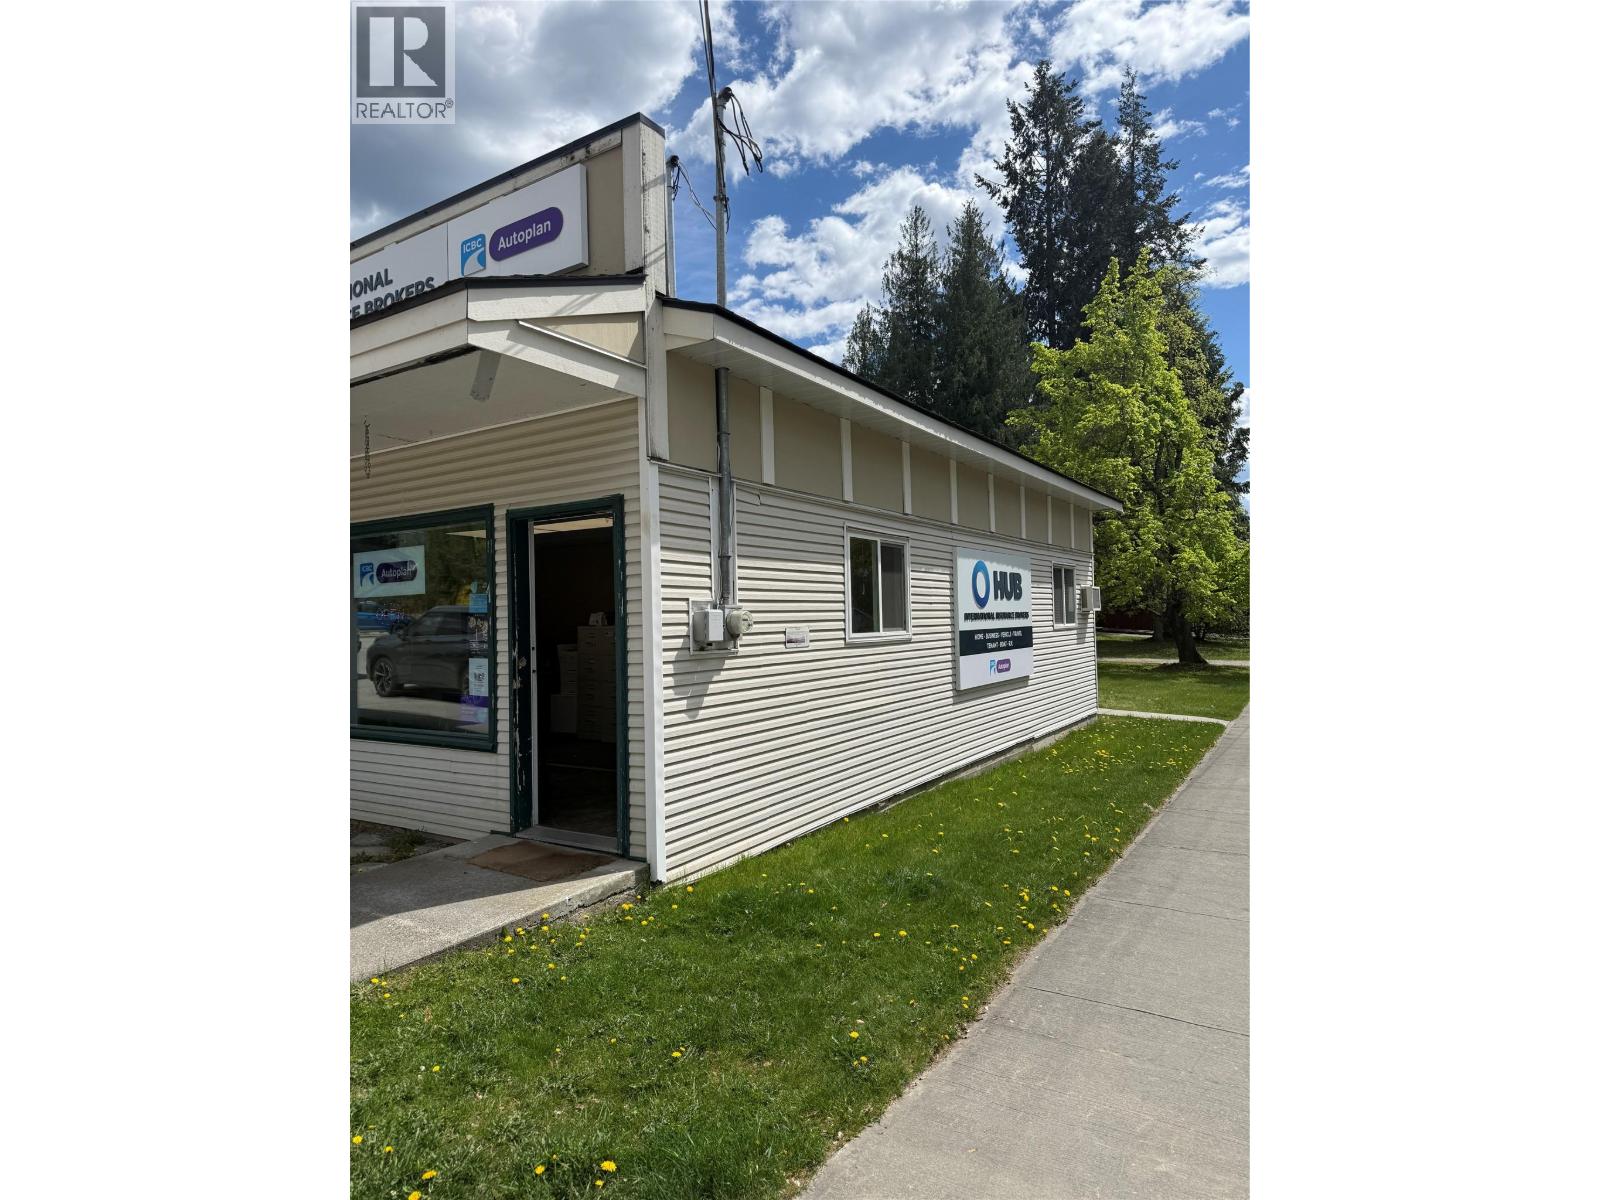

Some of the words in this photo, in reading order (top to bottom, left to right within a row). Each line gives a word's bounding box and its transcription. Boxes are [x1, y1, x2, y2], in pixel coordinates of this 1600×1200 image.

[463, 238, 482, 253] ICBC
[498, 220, 551, 251] Autoplan
[993, 570, 1023, 601] HUB
